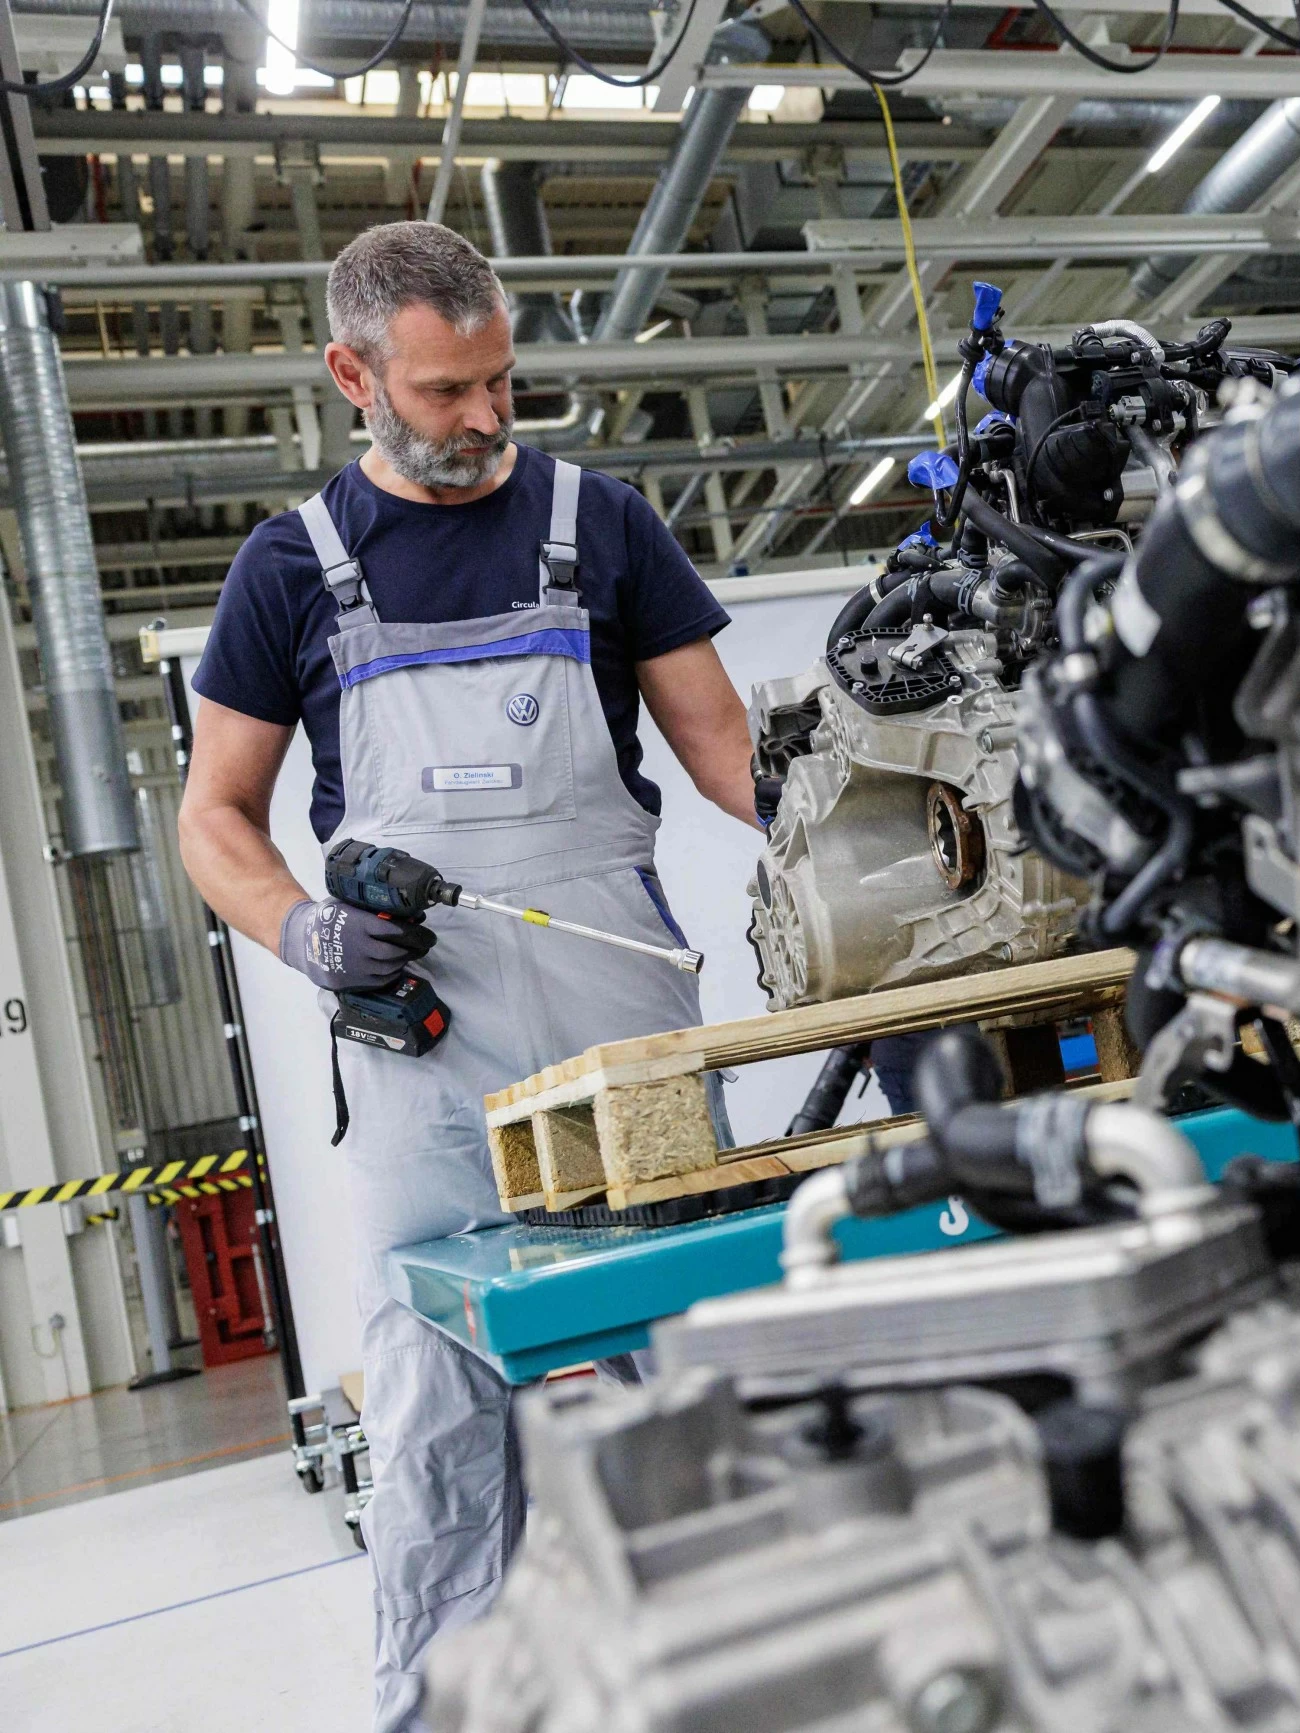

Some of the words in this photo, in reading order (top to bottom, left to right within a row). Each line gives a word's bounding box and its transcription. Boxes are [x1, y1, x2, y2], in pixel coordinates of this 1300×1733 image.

[507, 695, 538, 725] VW
[464, 771, 494, 779] Zielinski
[350, 1030, 367, 1040] 18V
